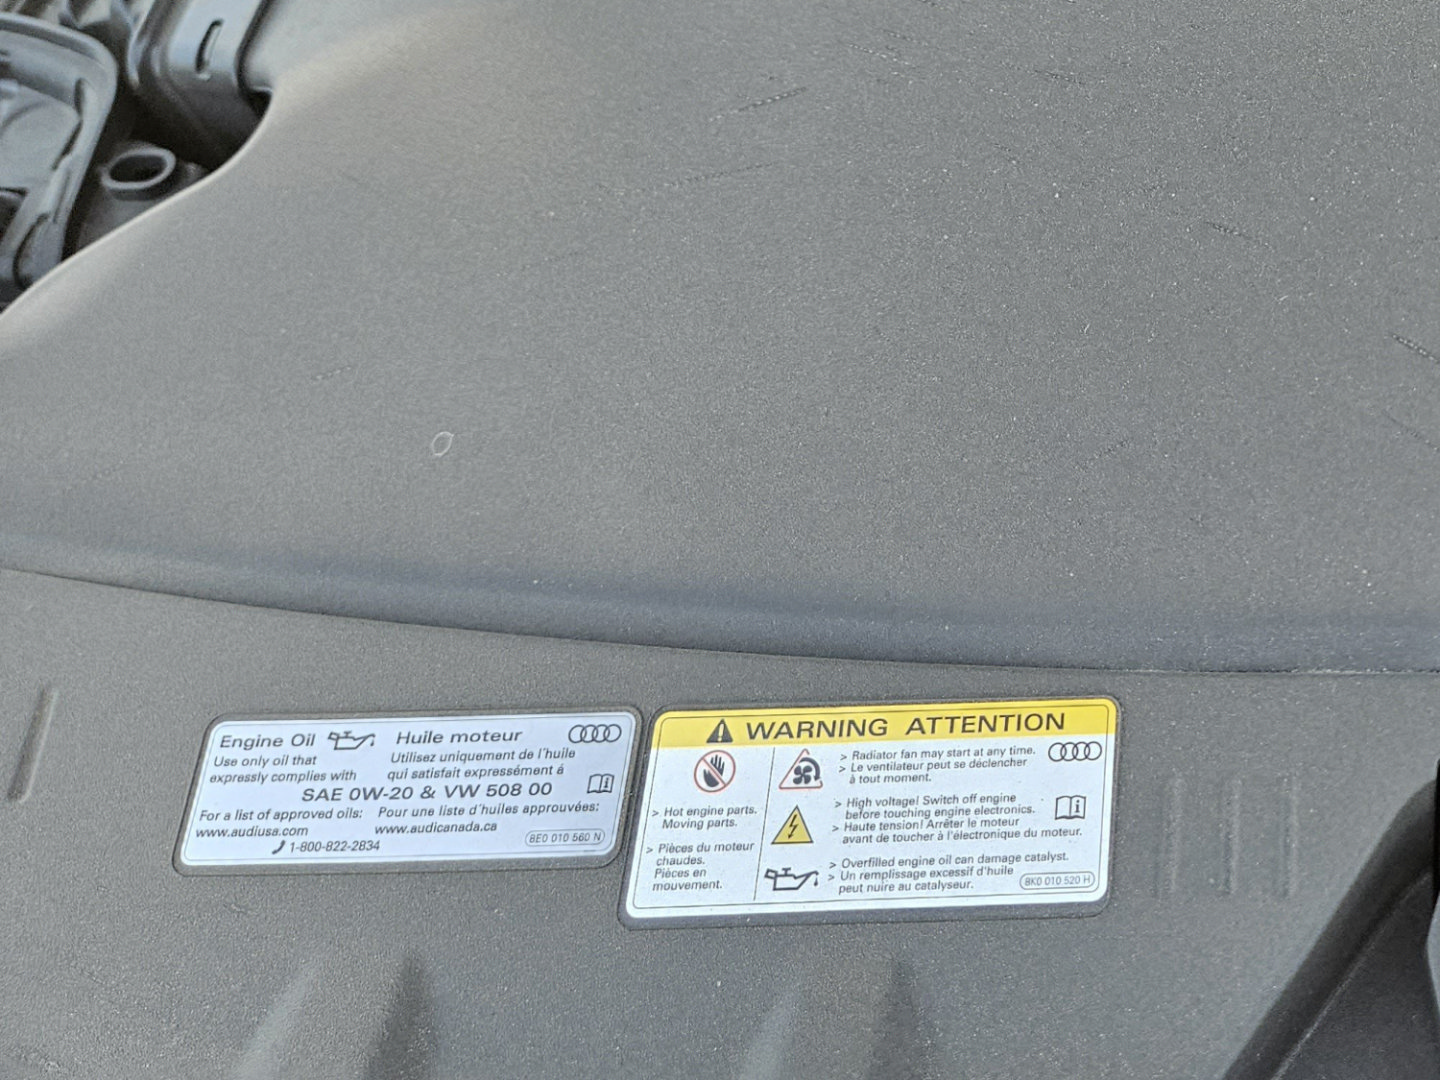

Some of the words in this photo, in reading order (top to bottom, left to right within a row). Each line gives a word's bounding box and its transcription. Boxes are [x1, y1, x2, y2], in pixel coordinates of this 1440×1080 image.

[747, 718, 887, 740] WARNING
[906, 712, 1064, 736] ATTENTION
[220, 734, 283, 751] Engine
[291, 733, 315, 747] Oil
[397, 730, 443, 745] Huile
[450, 730, 522, 744] moteur
[391, 751, 436, 764] Utilisez
[440, 750, 515, 764] uniquement
[519, 748, 534, 760] de
[852, 749, 897, 761] Radiator
[901, 748, 917, 760] fan
[921, 750, 944, 760] may
[947, 748, 970, 758] start
[973, 747, 983, 757] at
[987, 748, 1006, 760] any
[1010, 745, 1035, 756] time.
[214, 755, 237, 768] Use
[242, 754, 269, 769] only
[273, 754, 289, 767] oil
[293, 754, 317, 766] that
[851, 762, 863, 773] Le
[867, 761, 924, 772] ventilateur
[927, 758, 950, 772] peut
[954, 761, 966, 769] se
[969, 756, 1027, 769] déclencher
[210, 771, 268, 785] expressly
[271, 769, 326, 785] complies
[331, 769, 356, 782] with
[388, 767, 408, 783] qui
[411, 766, 460, 780] satisfait
[464, 764, 553, 780] expressément
[848, 773, 855, 785] à
[859, 774, 880, 784] tout
[884, 772, 931, 783] moment.
[302, 787, 343, 802] SAE
[349, 786, 413, 801] 0W-20
[420, 787, 435, 800] &
[445, 783, 480, 799] VW
[486, 782, 522, 798] 508
[529, 781, 552, 796] 00
[378, 806, 408, 818] Pour
[412, 808, 434, 818] une
[439, 804, 464, 817] liste
[523, 800, 599, 817] approuvées:
[846, 796, 872, 812] High
[875, 795, 919, 810] voltage!
[923, 794, 959, 806] Switch
[963, 792, 977, 804] off
[980, 792, 1016, 808] engine
[200, 809, 220, 822] For
[223, 812, 231, 821] a
[235, 808, 254, 821] list
[257, 808, 271, 821] of
[273, 807, 333, 823] approved
[337, 807, 362, 820] oils:
[664, 806, 683, 817] Hot
[687, 805, 723, 818] engine
[727, 805, 757, 817] parts.
[846, 808, 880, 820] before
[884, 807, 930, 822] touching
[935, 805, 971, 821] engine
[974, 804, 1035, 816] electronics.
[196, 825, 308, 838] www.audiusa.com
[375, 820, 497, 835] www.audicanada.ca
[662, 818, 703, 831] Moving
[707, 818, 737, 831] parts.
[844, 821, 876, 832] Haute
[879, 819, 923, 832] tension!
[926, 818, 964, 829] Arrêter
[967, 817, 976, 828] le
[981, 818, 1019, 828] moteur
[842, 834, 872, 845] avant
[876, 832, 889, 844] de
[893, 831, 934, 843] toucher
[936, 830, 943, 841] à
[1024, 827, 1037, 838] du
[1041, 827, 1082, 838] moteur.
[291, 839, 380, 853] 1-800-822-2834
[659, 842, 693, 854] Pièces
[697, 842, 710, 853] du
[714, 842, 754, 852] moteur
[657, 855, 705, 867] chaudes.
[842, 856, 895, 869] Overfilled
[898, 855, 935, 869] engine
[939, 854, 952, 866] oil
[955, 856, 974, 865] can
[978, 853, 1021, 868] damage
[1025, 850, 1068, 864] catalyst.
[654, 867, 689, 879] Pièces
[693, 868, 706, 878] en
[841, 870, 855, 882] Un
[860, 867, 926, 884] remplissage
[930, 865, 974, 878] excessif
[653, 879, 722, 892] mouvement.
[839, 883, 863, 896] peut
[867, 881, 895, 893] nuire
[898, 883, 911, 892] au
[915, 879, 973, 892] catalyseur.
